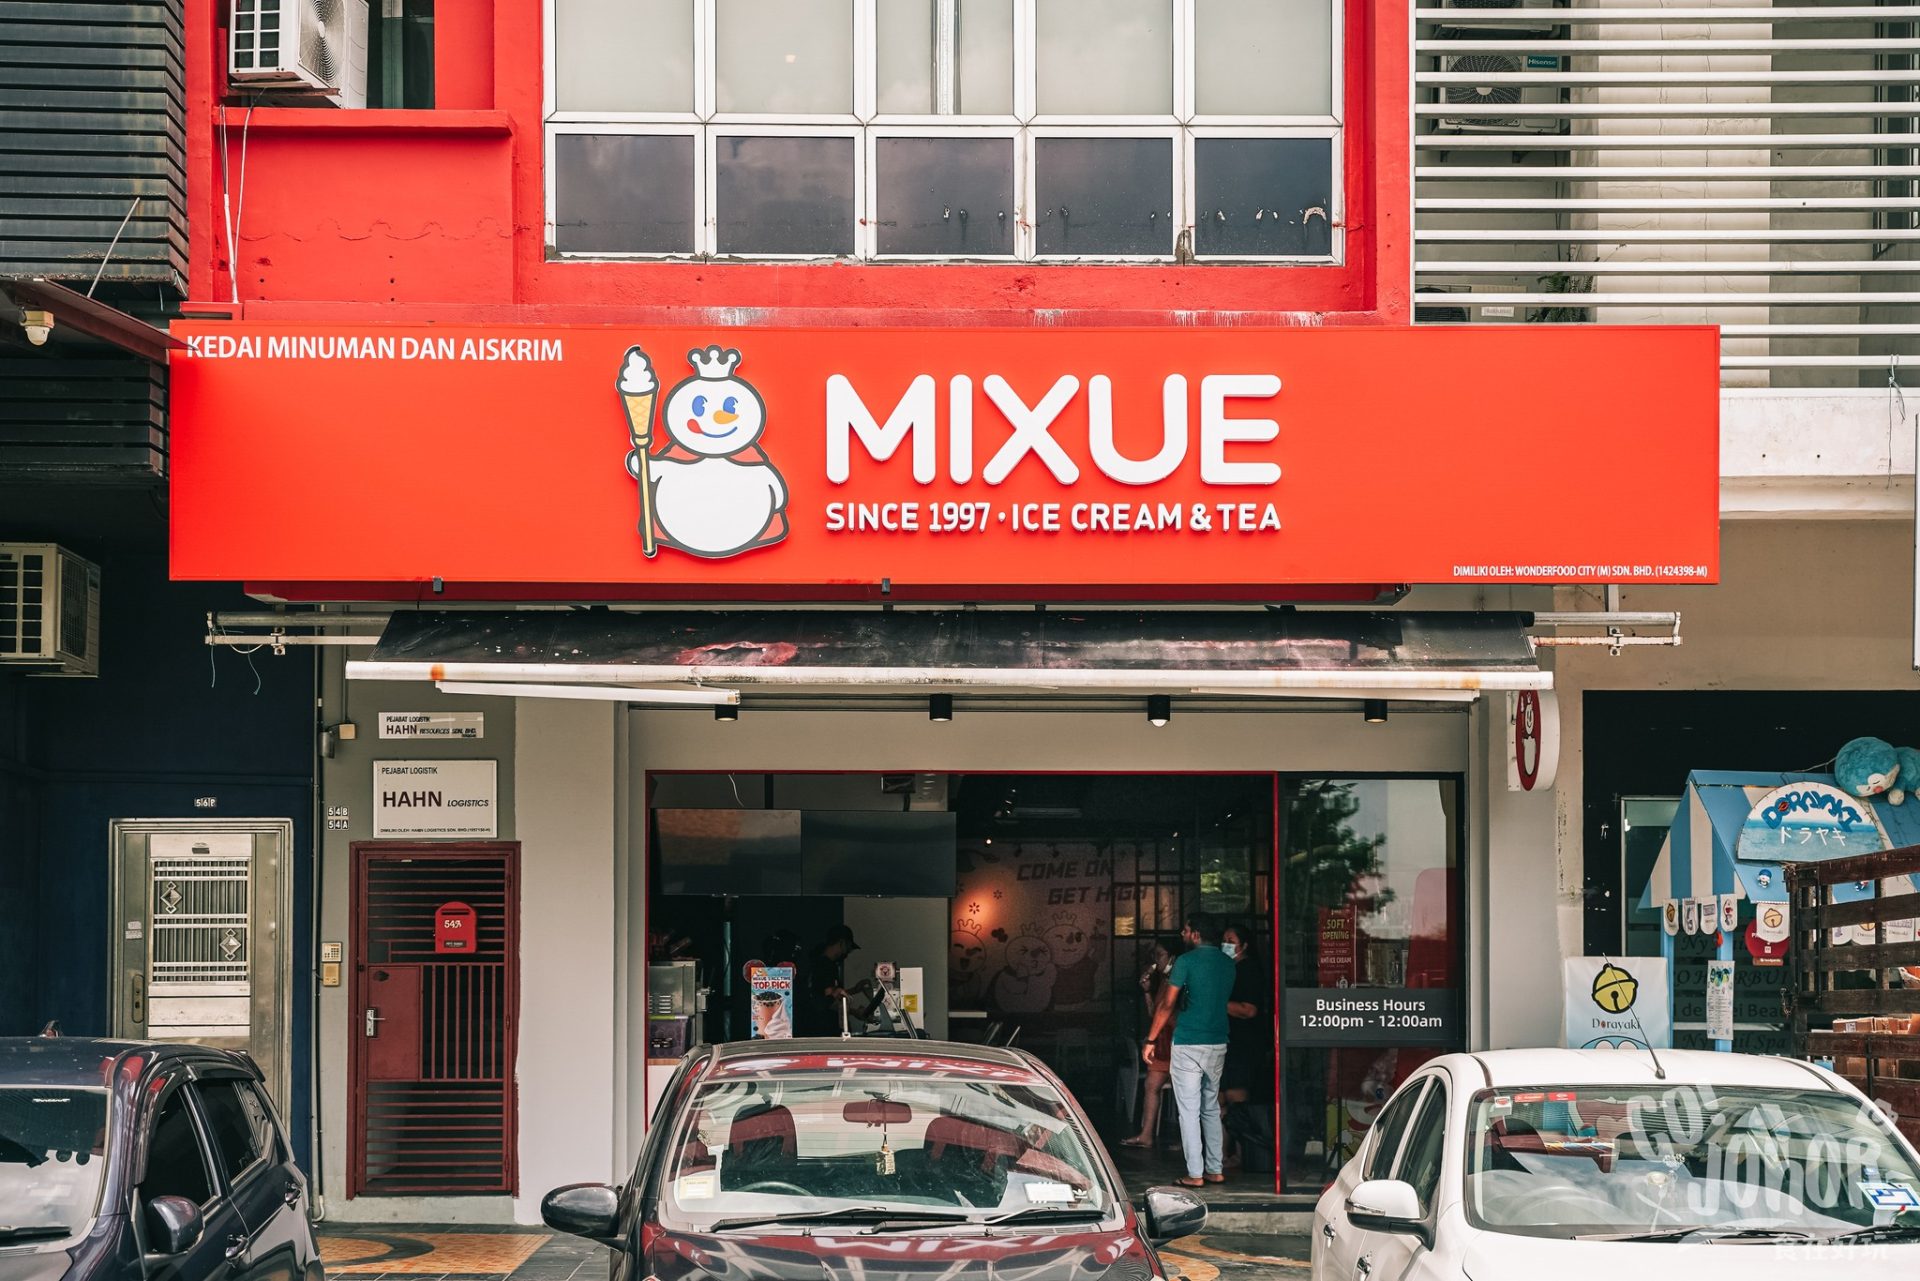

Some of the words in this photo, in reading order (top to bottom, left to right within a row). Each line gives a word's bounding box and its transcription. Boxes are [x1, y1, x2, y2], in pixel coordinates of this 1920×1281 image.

[1528, 58, 1557, 66] Hisense
[187, 336, 262, 358] KEDAI
[268, 337, 395, 359] MINUMAN
[402, 338, 455, 360] DAN
[460, 339, 563, 361] AISKRIM
[826, 373, 1282, 485] MIXUE
[825, 502, 919, 531] SINCE
[929, 502, 991, 531] 1997
[1012, 503, 1061, 531] ICE
[1071, 503, 1182, 531] CREAM
[1190, 503, 1212, 531] &
[1216, 503, 1282, 531] TEA
[1453, 565, 1488, 577] DIMILIKI
[1489, 565, 1514, 577] OLEH:
[1515, 565, 1576, 577] WONDERFOOD
[1577, 565, 1596, 577] CITY
[1597, 565, 1611, 578] (M)
[1612, 565, 1632, 577] SDN.
[1633, 565, 1655, 577] BHD.
[1655, 565, 1708, 578] (1424398-M)
[386, 725, 418, 735] HAHN
[381, 767, 409, 775] PEJABAT
[409, 767, 438, 775] LOGISTIK
[382, 791, 442, 808] HAHN
[447, 799, 489, 808] LOGISTICS
[328, 807, 348, 816] 54B
[328, 820, 348, 829] 54A
[1780, 826, 1846, 847] ドラヤキ
[1016, 861, 1078, 881] COME
[1047, 886, 1091, 905] GET
[1326, 918, 1346, 930] SOFT
[1322, 931, 1350, 941] OPENING
[772, 981, 791, 989] PICK
[1316, 998, 1379, 1012] Business
[1383, 998, 1426, 1012] Hours
[1299, 1014, 1364, 1031] 12:00pm
[1378, 1014, 1442, 1028] 12:00am
[1592, 1015, 1642, 1031] Dorayaki
